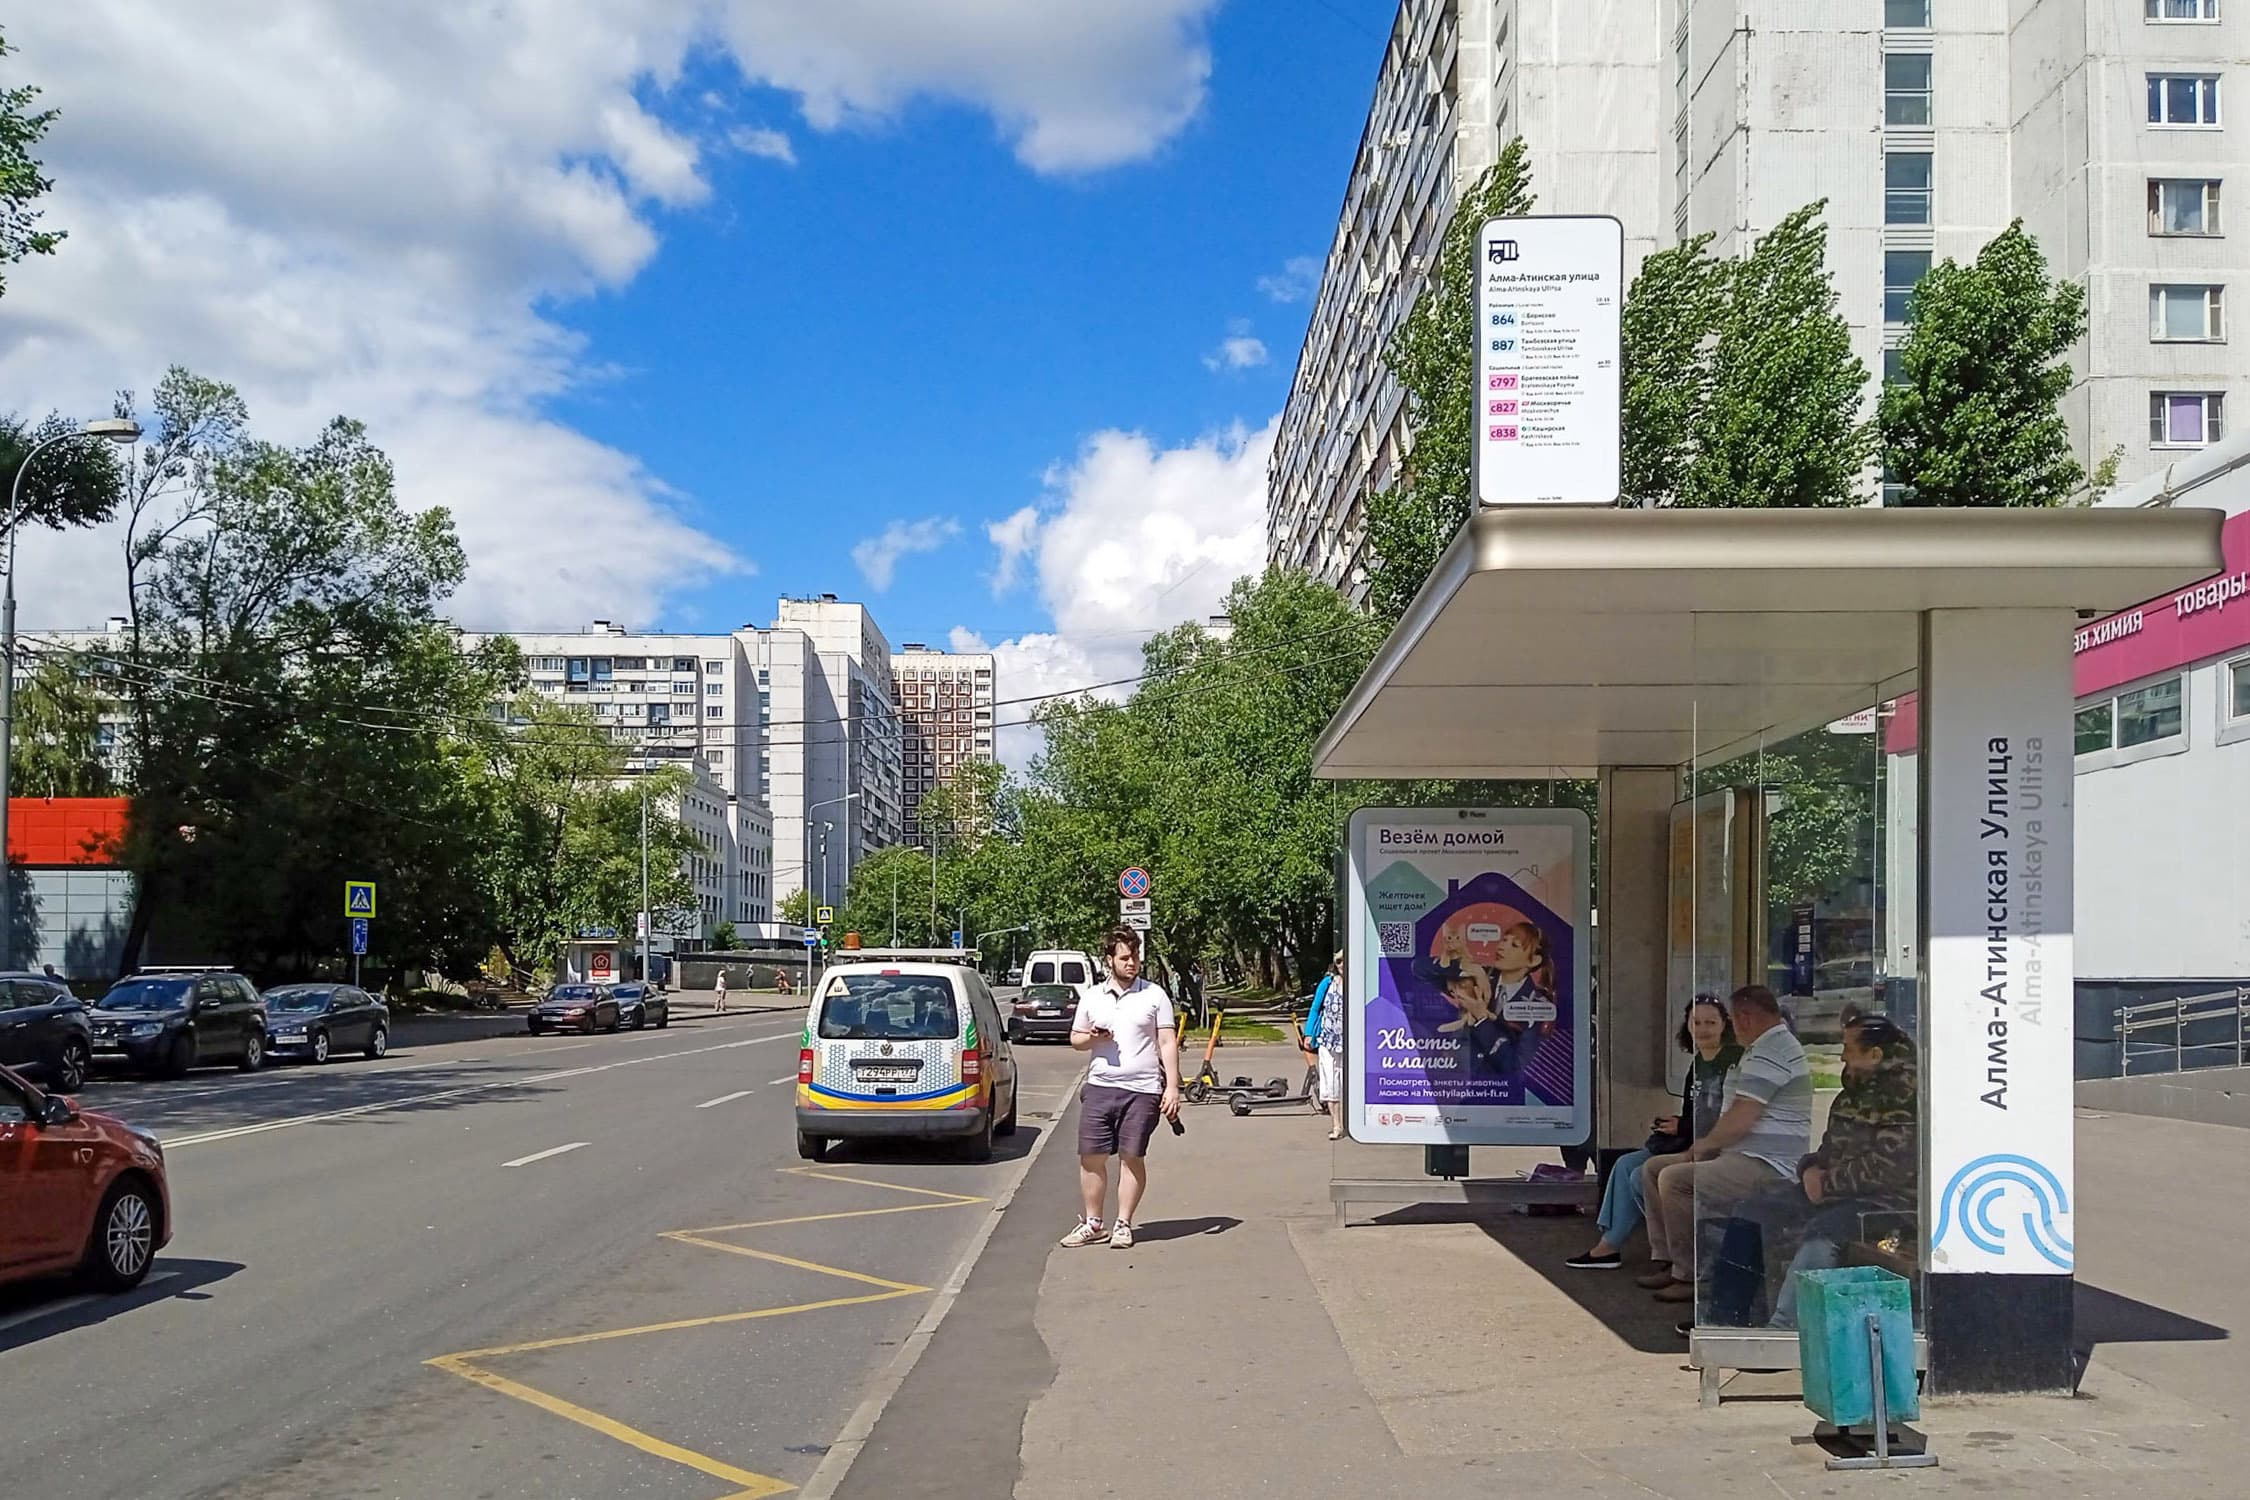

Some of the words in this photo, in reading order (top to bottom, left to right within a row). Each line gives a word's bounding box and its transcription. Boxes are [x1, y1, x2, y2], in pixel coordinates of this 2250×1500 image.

[1489, 273, 1567, 282] Алма-Атинская
[1569, 273, 1600, 283] улица
[1492, 314, 1515, 325] 864
[1492, 340, 1515, 351] 887
[2092, 610, 2143, 647] химия
[2174, 572, 2246, 617] товары
[2019, 737, 2043, 812] Ulitsa
[1980, 737, 2012, 840] Улица
[1380, 829, 1438, 844] Везём
[1443, 830, 1505, 847] домой
[1379, 891, 1425, 899] Желточек
[1379, 903, 1402, 911] ищет
[1404, 902, 1426, 911] дом!
[2020, 818, 2048, 1026] Alma-Atinskaya
[1980, 849, 2009, 1110] Алма-Атинская
[1377, 1028, 1461, 1050] Хвосты
[1382, 1056, 1396, 1069] и
[1397, 1056, 1458, 1070] лапки
[1379, 1077, 1431, 1088] Посмотреть
[1423, 1089, 1509, 1098] hvostyilapki.wi-fi.ru
